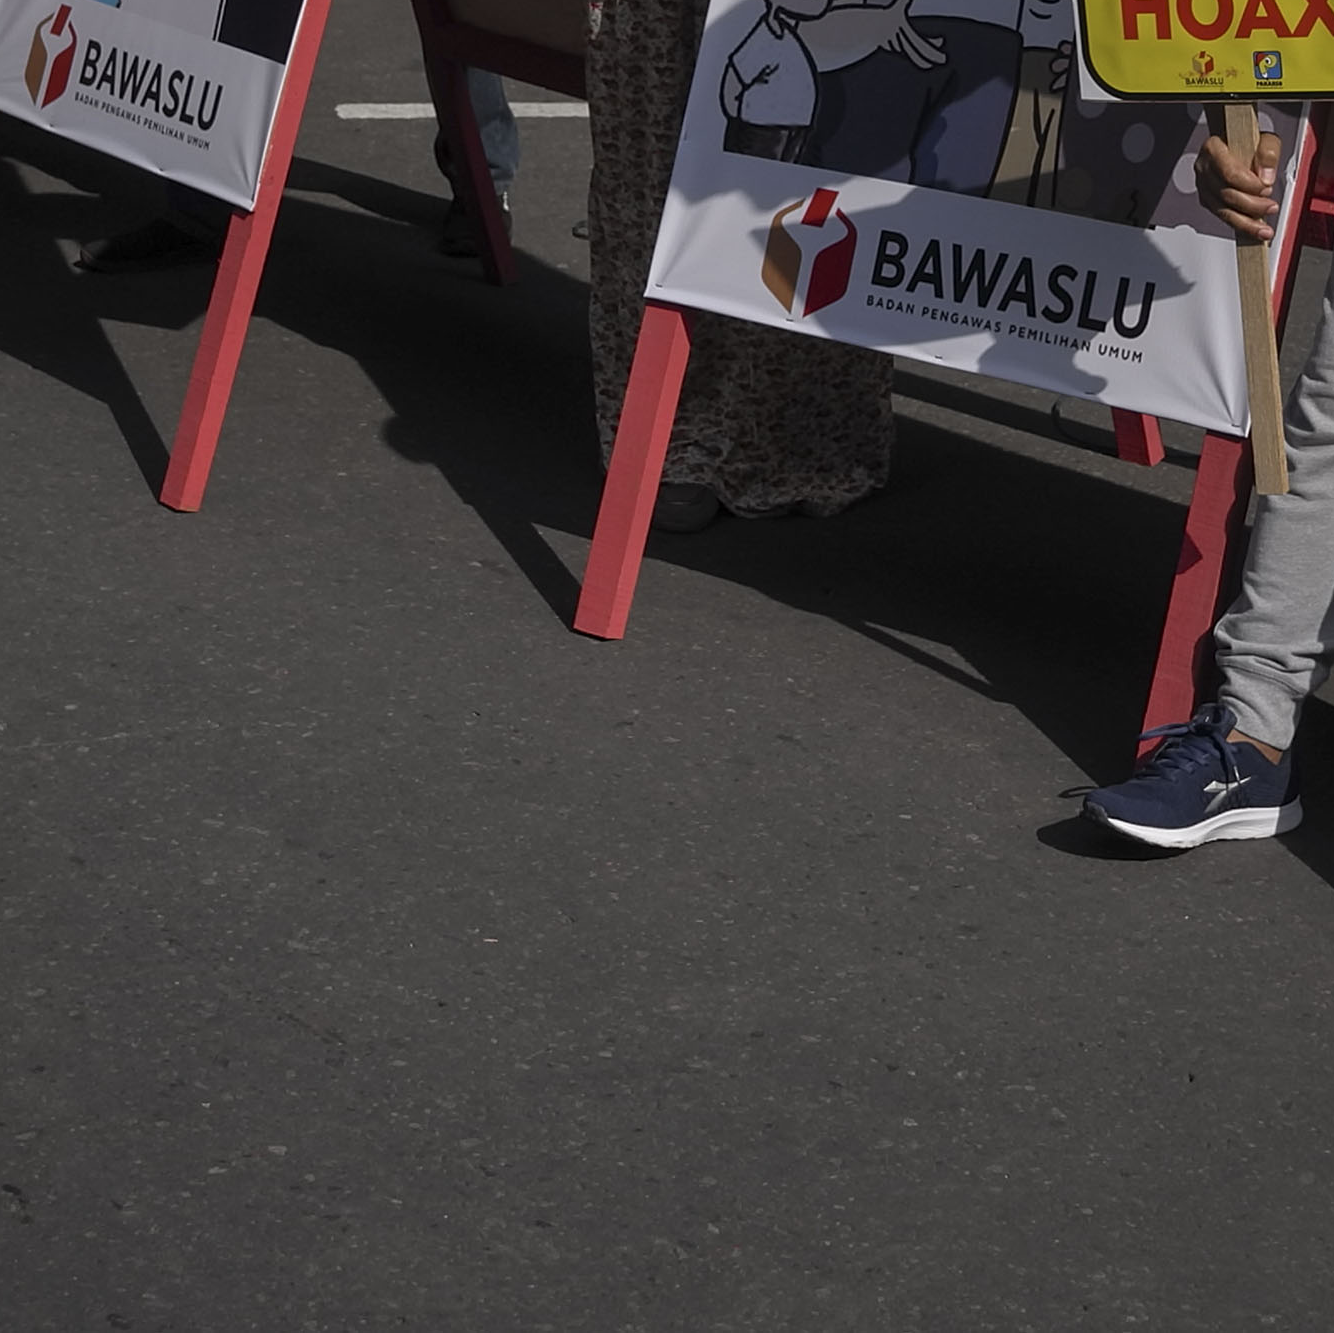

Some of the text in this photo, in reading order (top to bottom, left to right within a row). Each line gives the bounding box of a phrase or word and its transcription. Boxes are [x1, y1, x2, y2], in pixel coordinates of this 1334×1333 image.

[79, 38, 224, 131] BAWASLU
[1184, 77, 1225, 86] BAWASLU
[75, 91, 211, 151] BADAN PENGAWAS PEMILIHAN UMUM
[870, 229, 1156, 339] BAWASLU
[866, 294, 1143, 363] BADAN PENGAWAS PEMILIHAN UMUM
